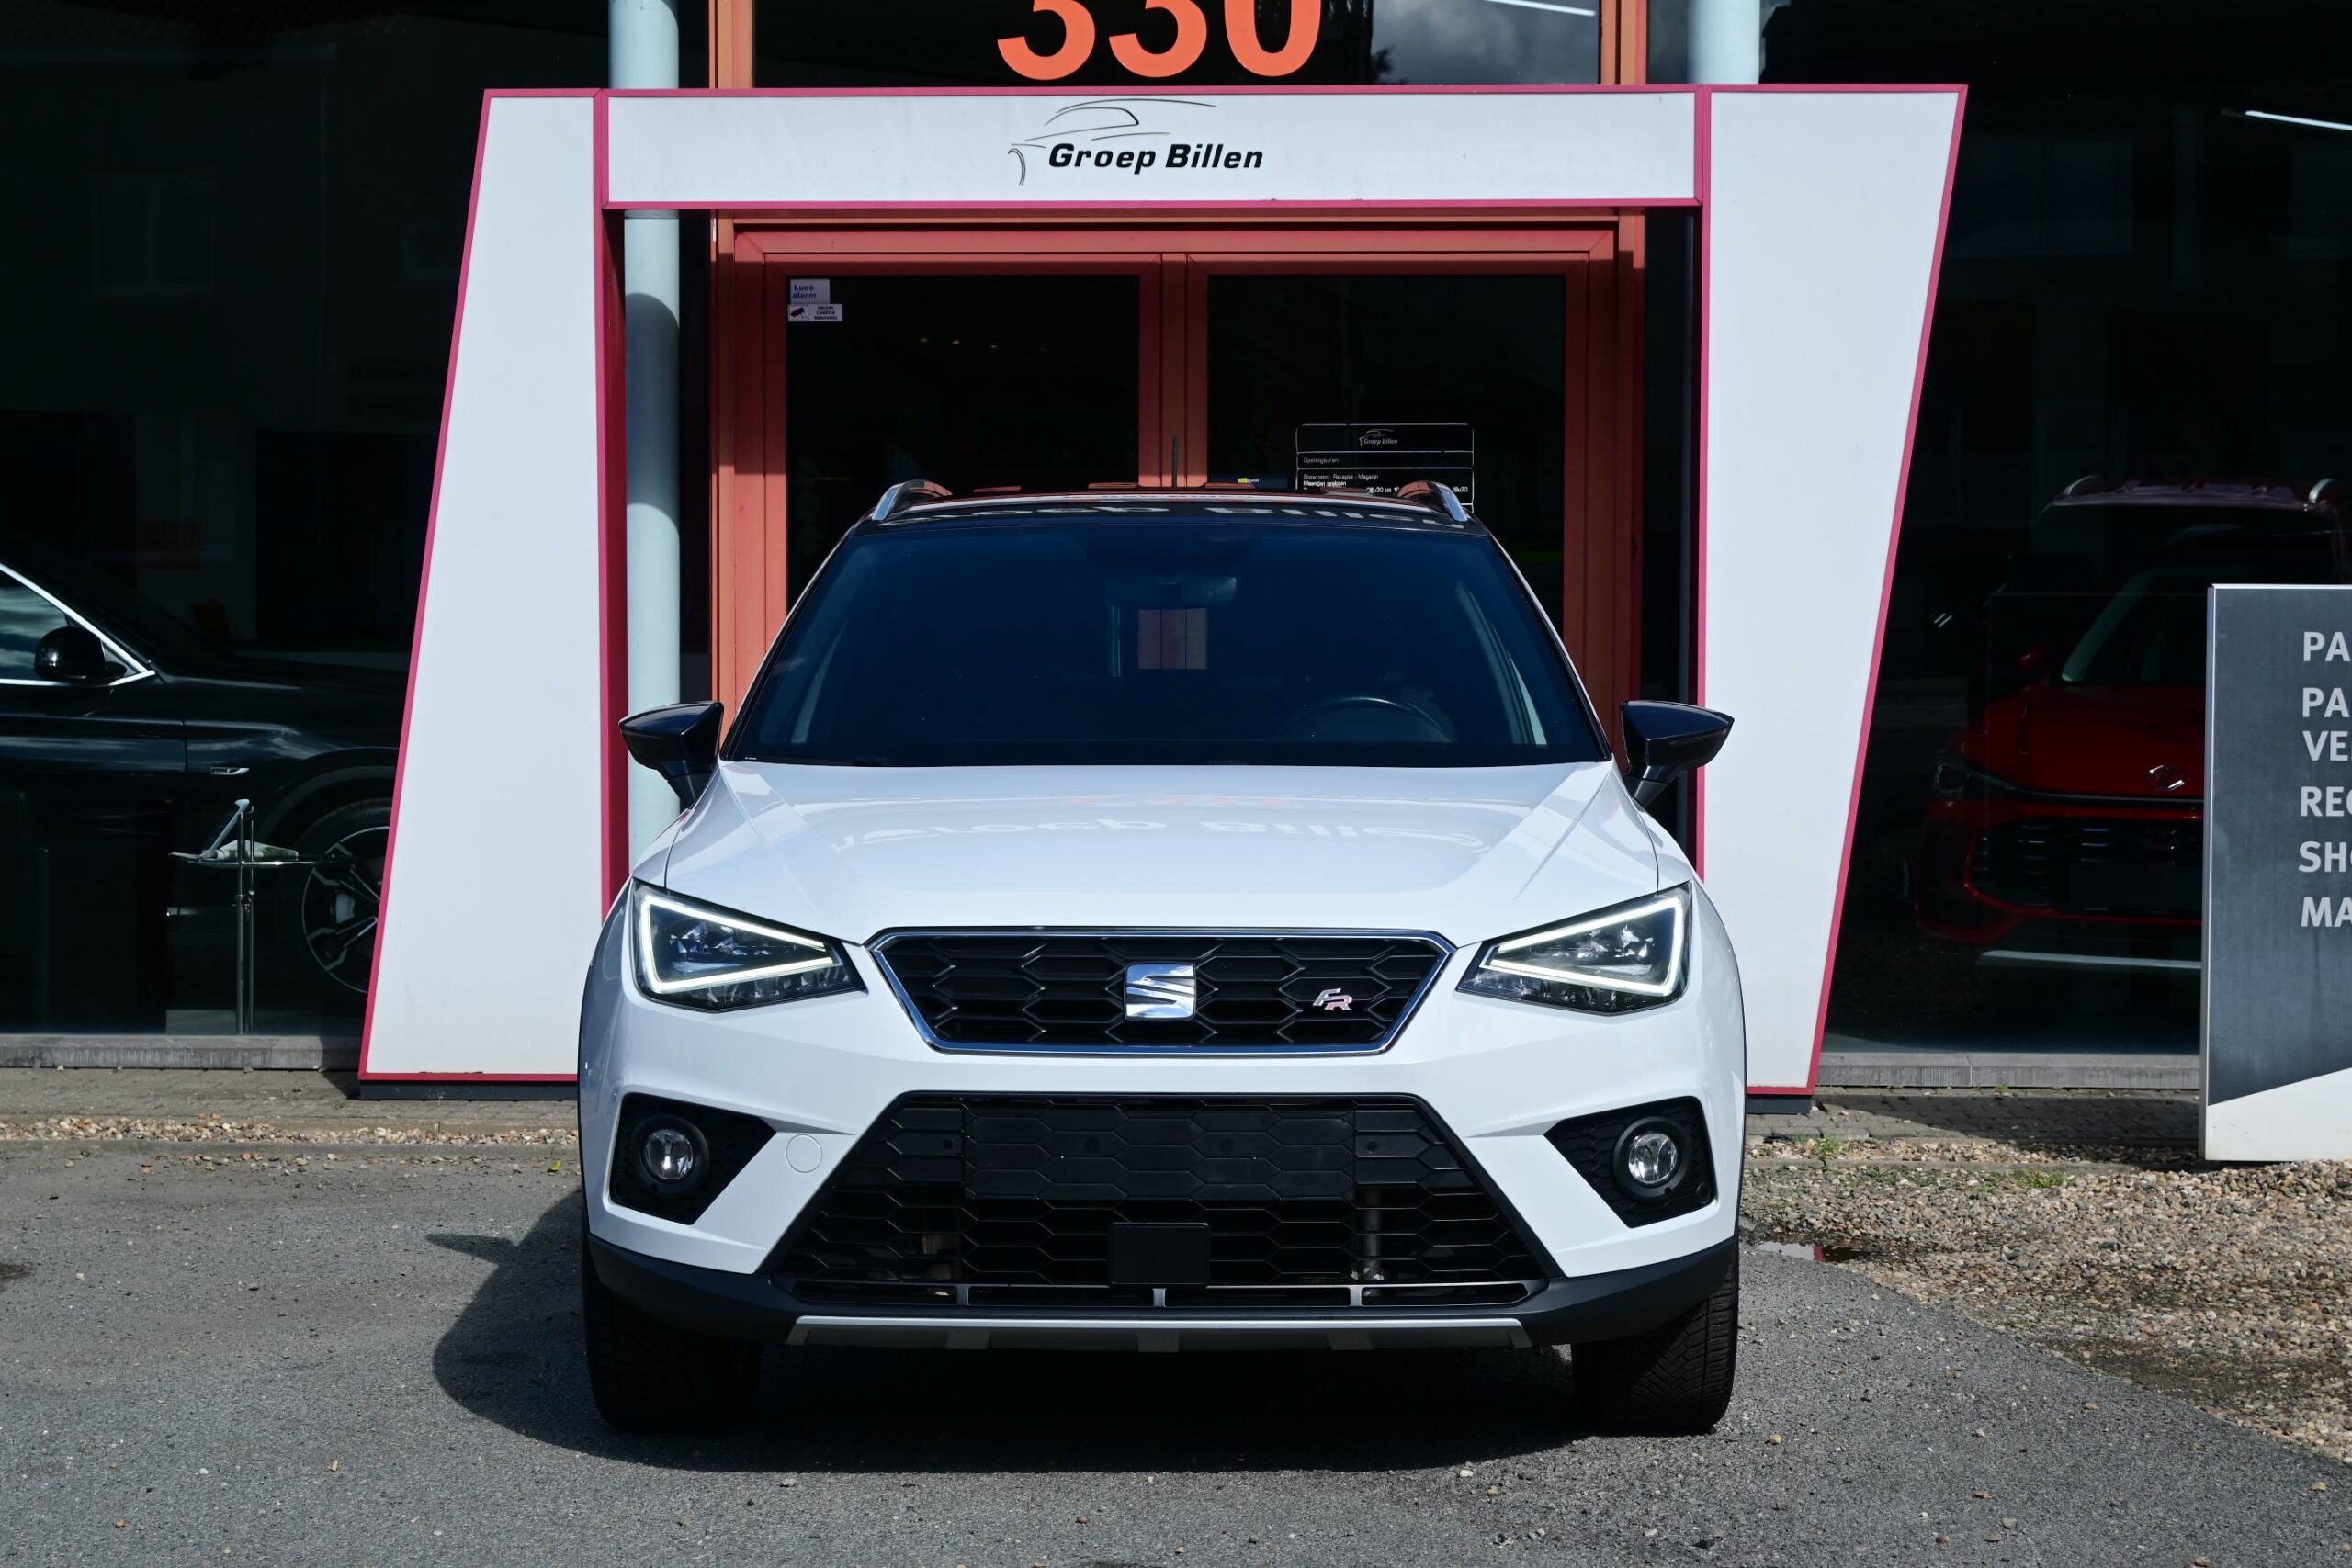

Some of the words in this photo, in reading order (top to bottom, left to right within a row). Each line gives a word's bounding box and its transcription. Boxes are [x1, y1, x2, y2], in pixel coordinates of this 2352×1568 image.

[998, 0, 1321, 80] 330
[1048, 143, 1157, 175] Groep
[1166, 143, 1263, 169] Billen
[2302, 730, 2352, 761] VE
[2298, 840, 2352, 873] SH
